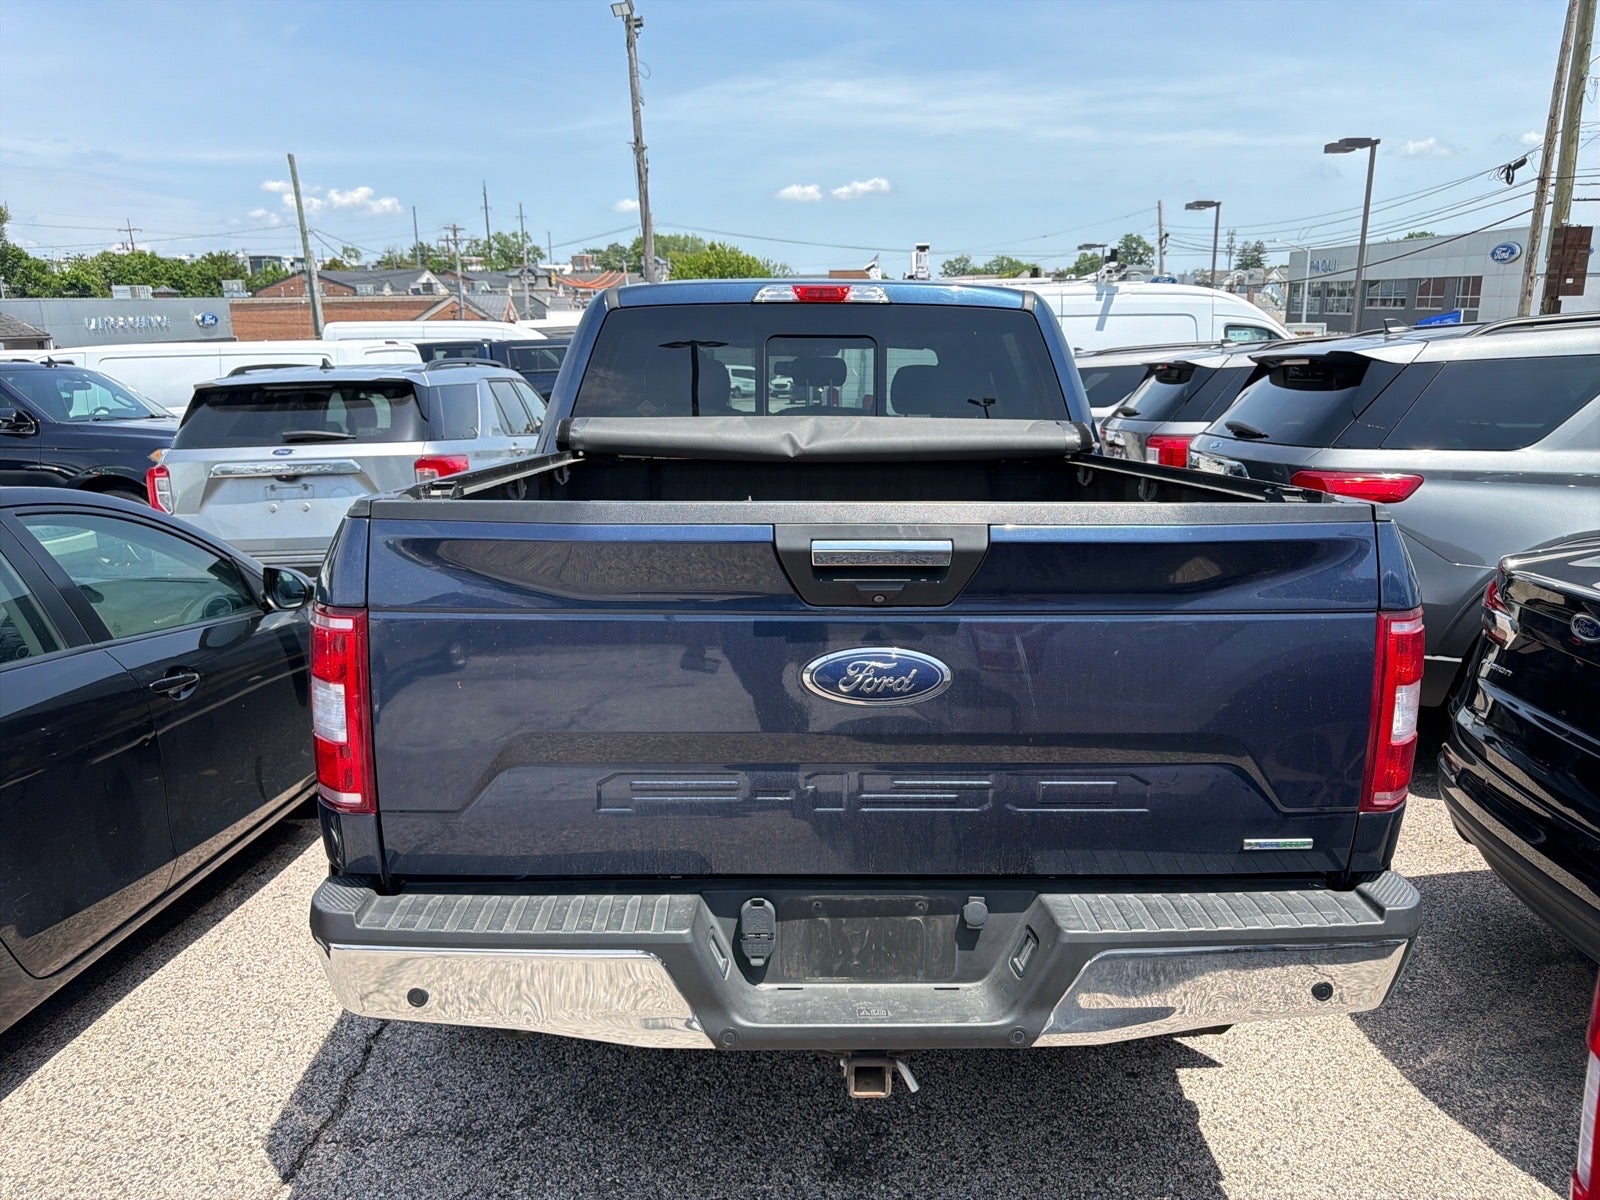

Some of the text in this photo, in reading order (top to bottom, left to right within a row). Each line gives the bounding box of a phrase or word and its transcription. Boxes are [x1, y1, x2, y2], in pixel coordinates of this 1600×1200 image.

[1574, 618, 1597, 637] Ford
[837, 660, 918, 694] Ford
[596, 771, 1151, 813] F-150
